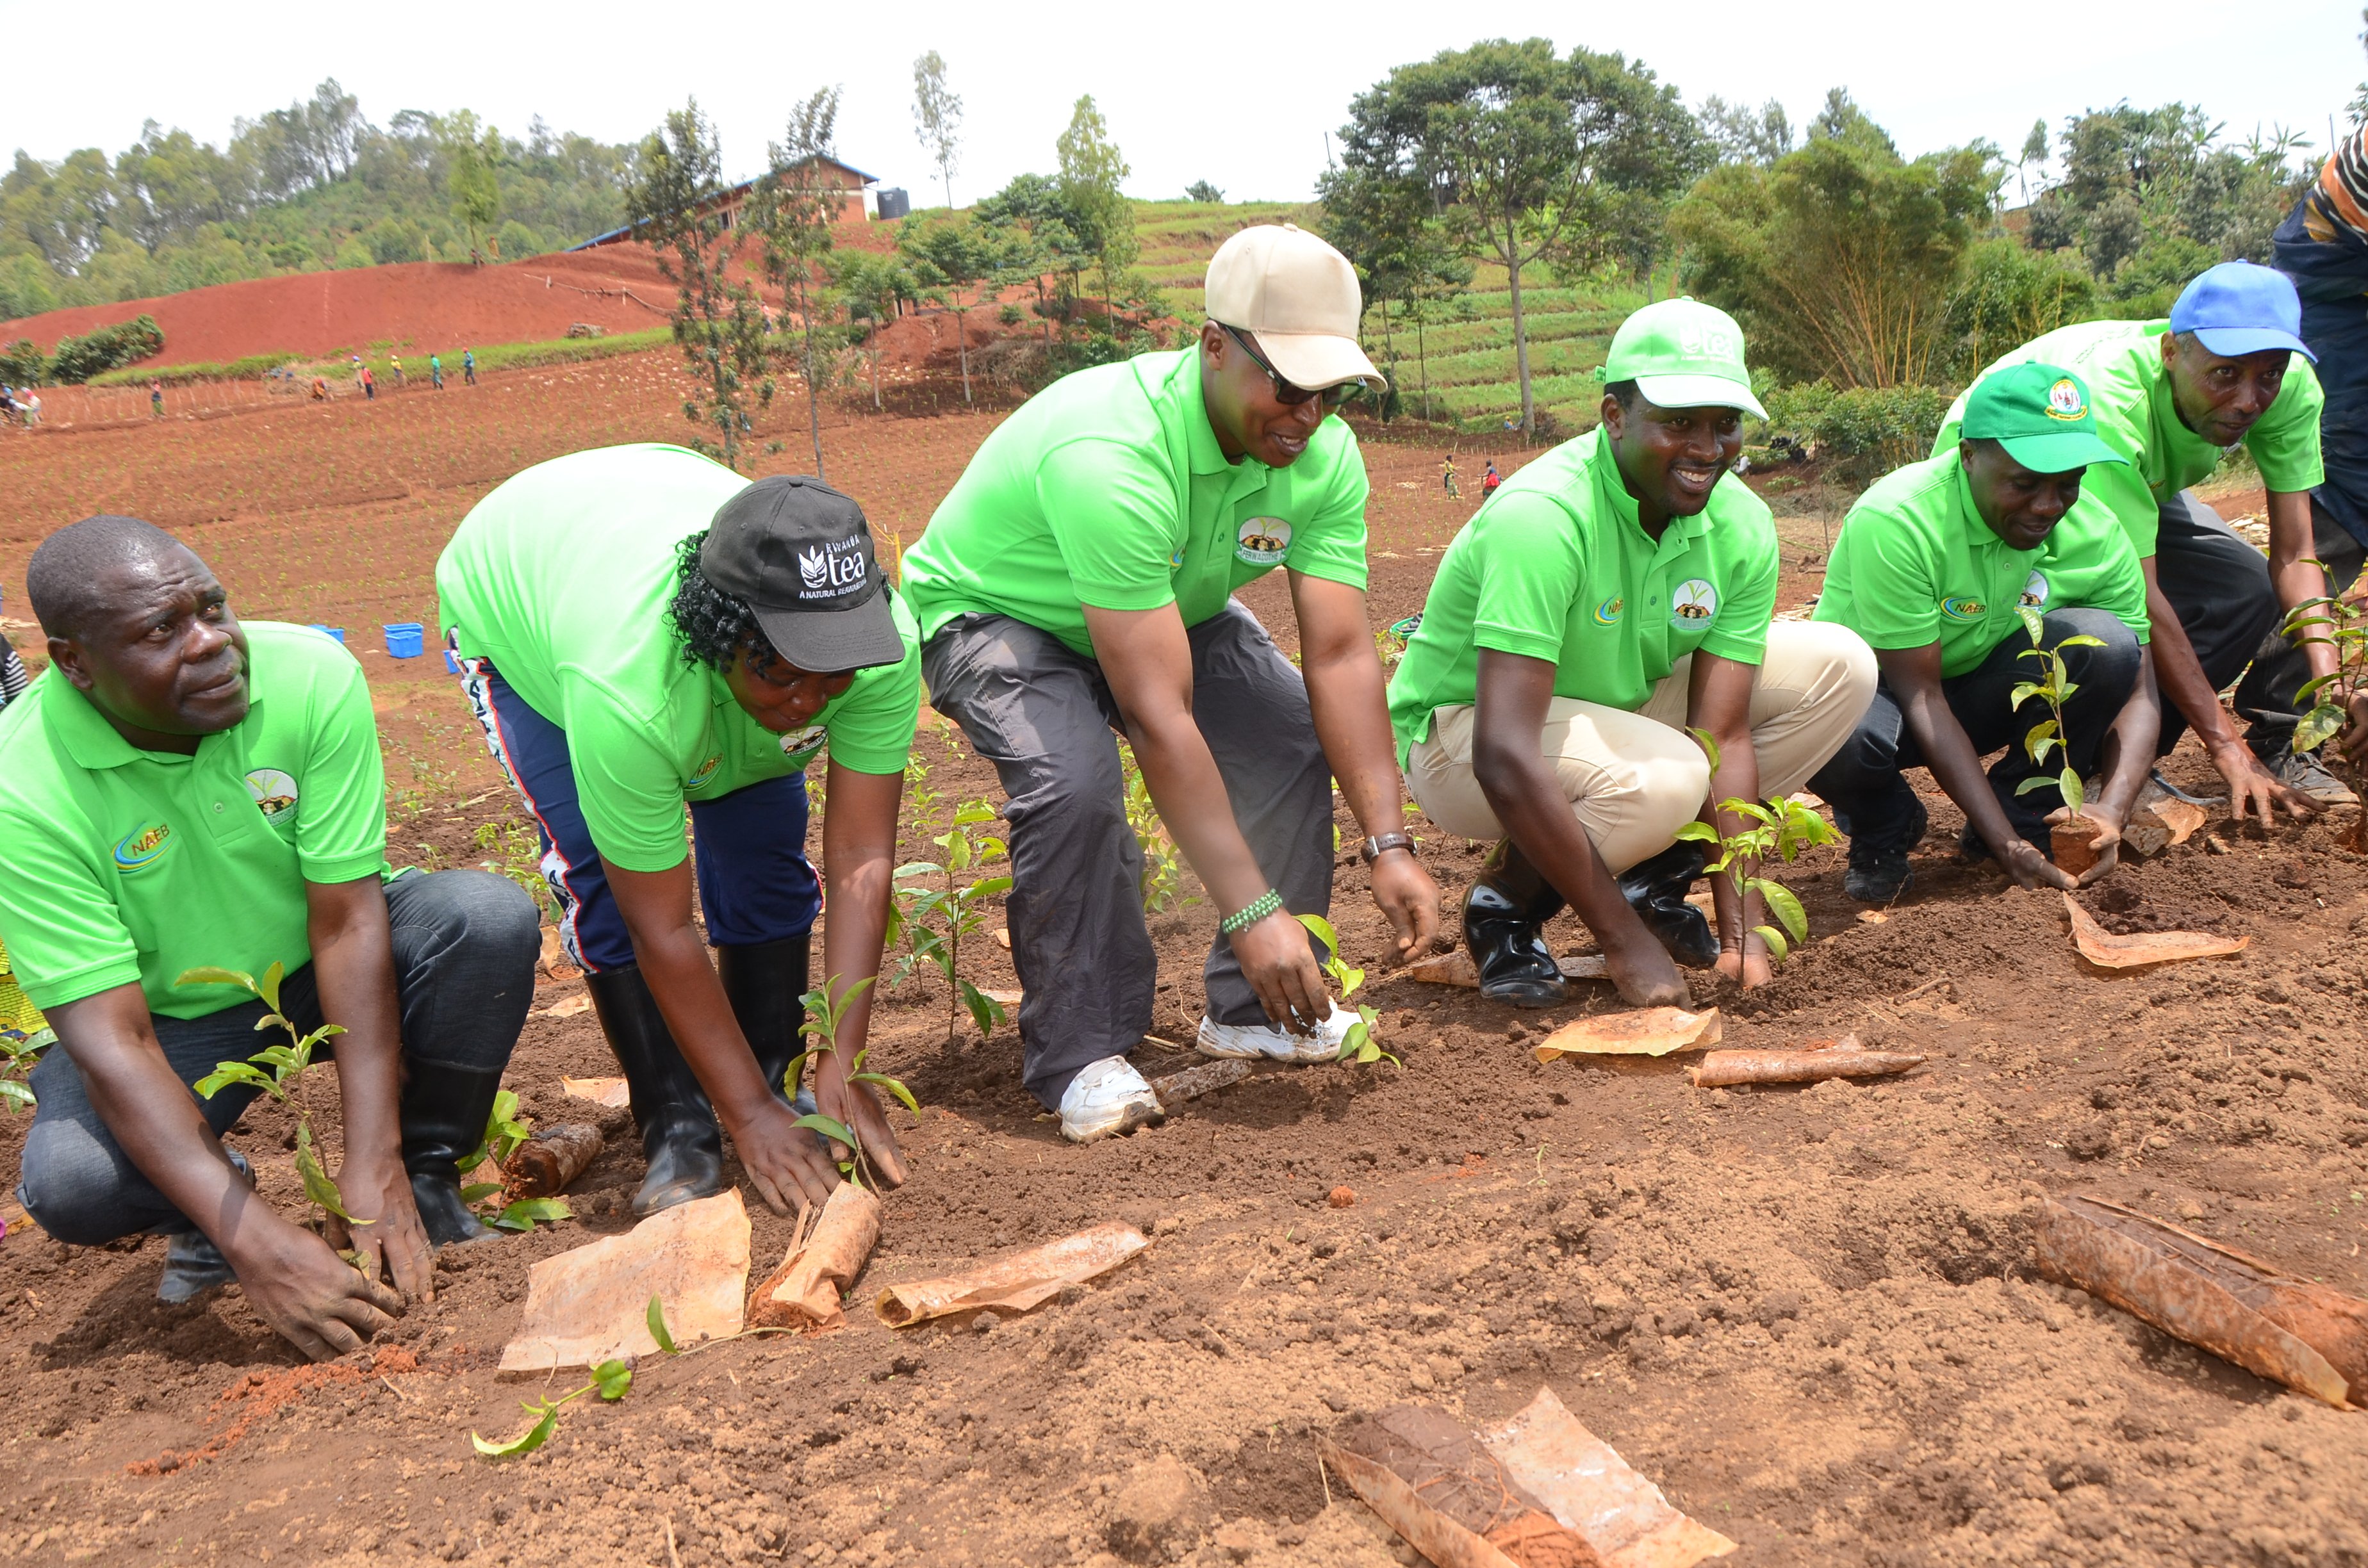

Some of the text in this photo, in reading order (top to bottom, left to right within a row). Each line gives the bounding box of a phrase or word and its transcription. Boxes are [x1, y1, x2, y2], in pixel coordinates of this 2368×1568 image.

[825, 534, 860, 553] RWANDA
[828, 551, 865, 586] tea
[799, 591, 805, 599] A
[805, 589, 836, 599] NATURAL
[1955, 603, 1986, 614] NAEB
[696, 753, 723, 779] NAEB
[131, 824, 170, 856] NAEB
